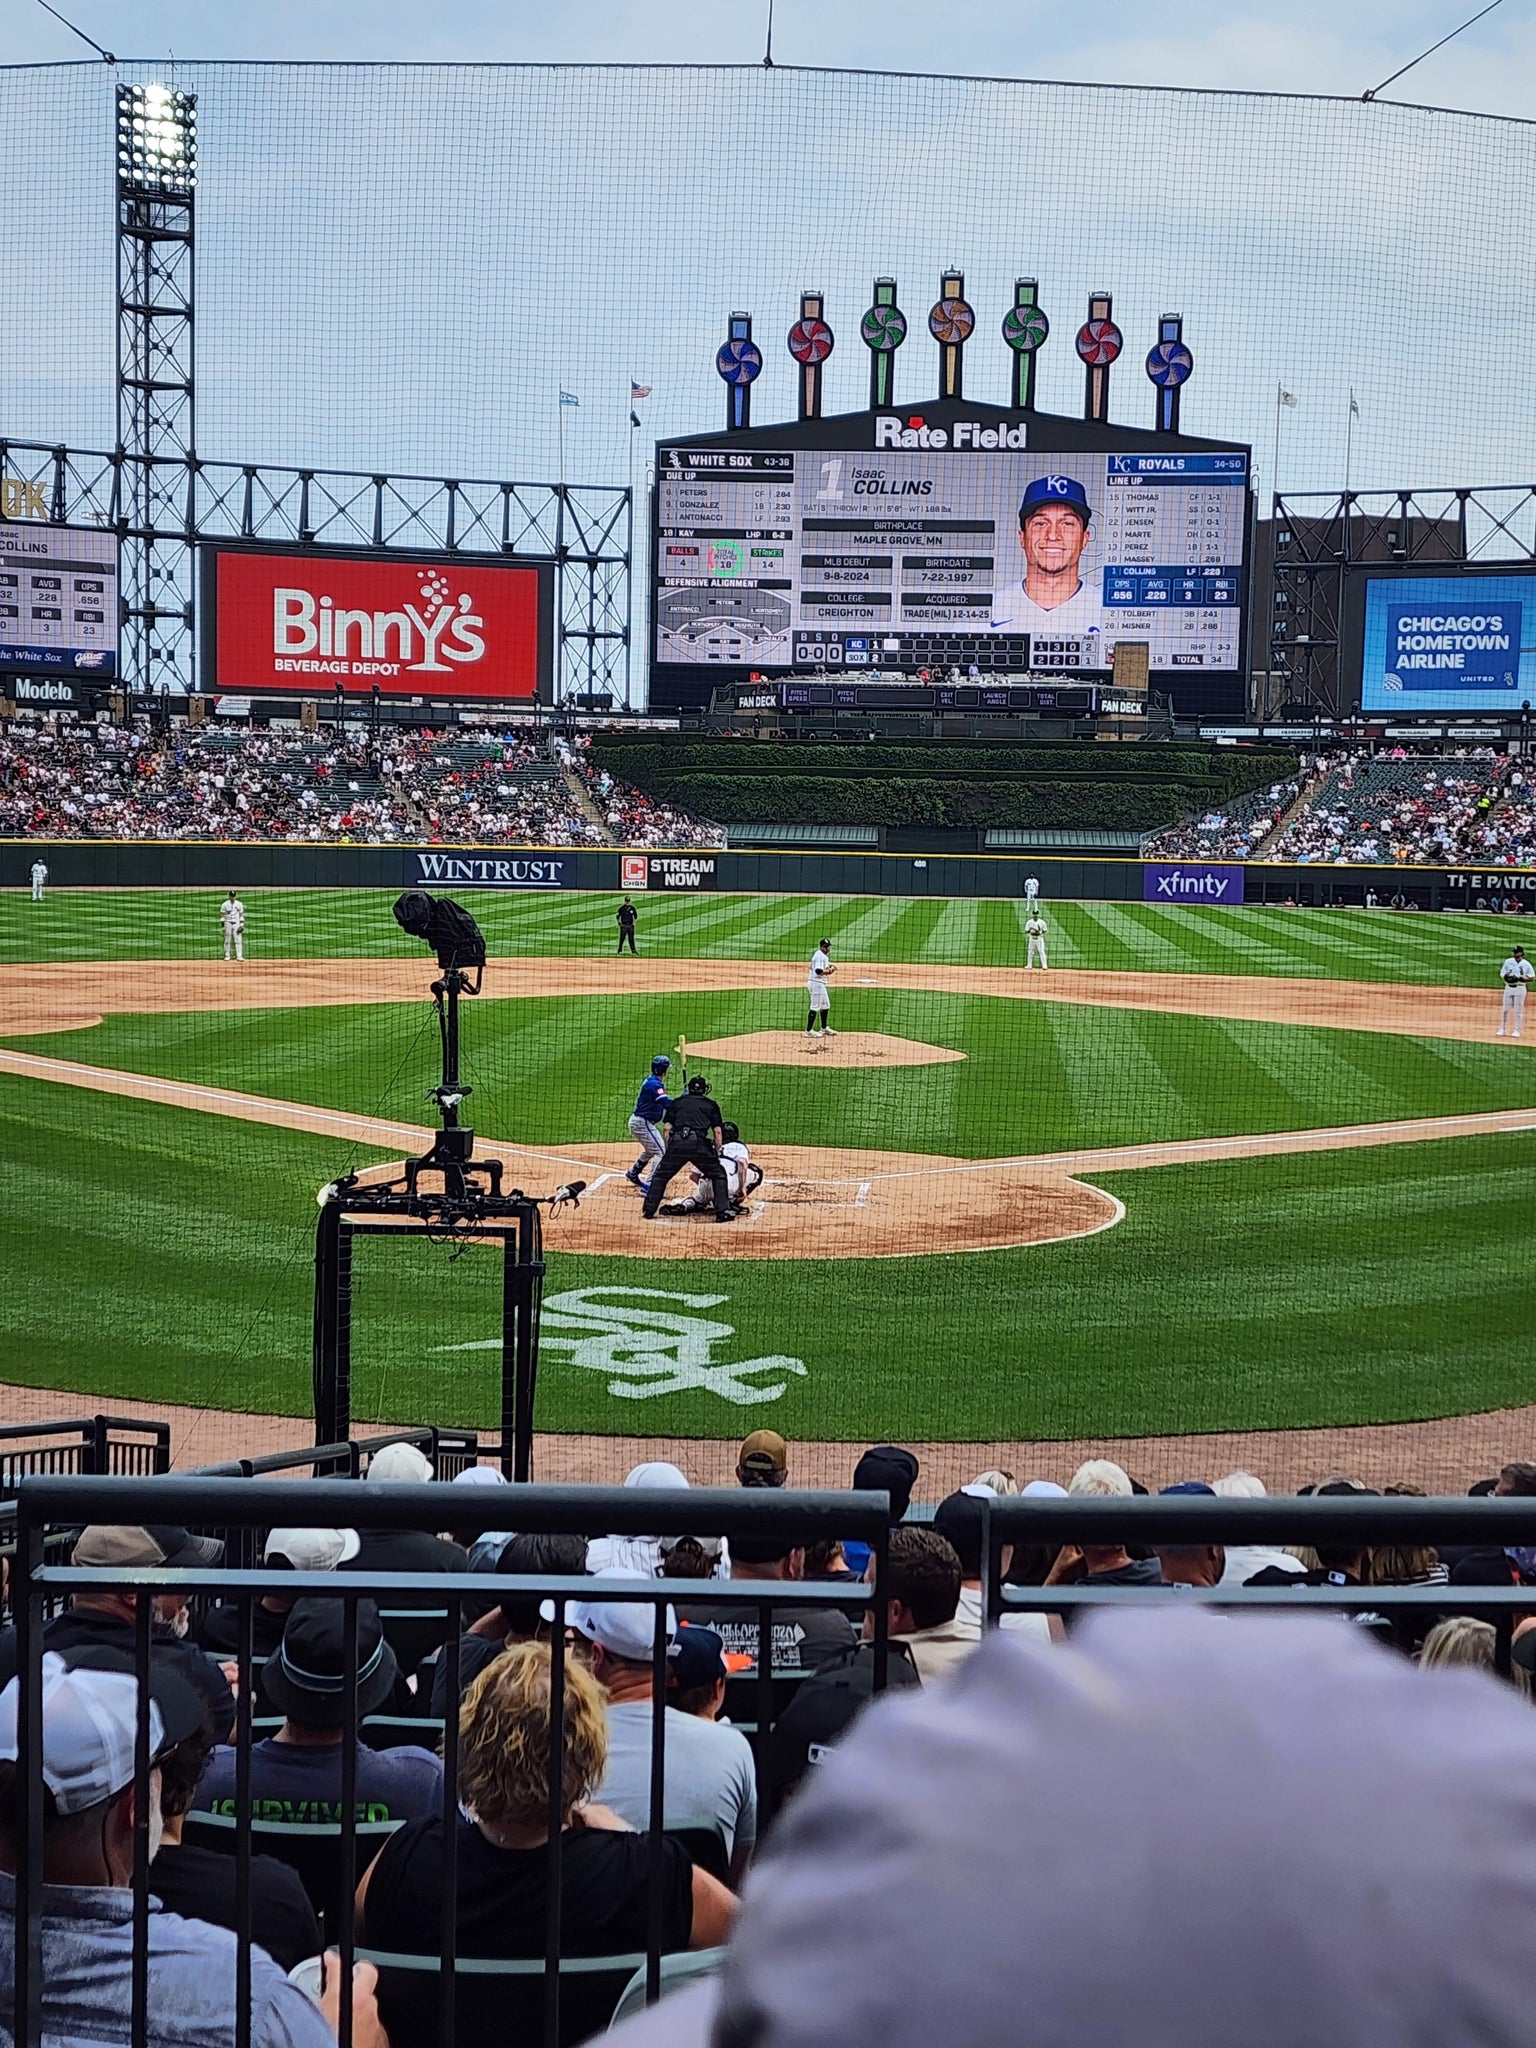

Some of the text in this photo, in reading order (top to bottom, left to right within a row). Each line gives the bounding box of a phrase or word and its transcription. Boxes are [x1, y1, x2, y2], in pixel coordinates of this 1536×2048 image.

[875, 416, 1026, 448] Rate Field
[689, 455, 725, 466] WHITE
[729, 456, 753, 466] SOX
[1113, 456, 1242, 473] KC ROYALS 34-50
[666, 472, 696, 480] DUE UP
[851, 468, 886, 479] Isaac
[1047, 476, 1067, 494] KC
[1109, 477, 1143, 485] LINE UP
[853, 480, 933, 495] COLLINS
[755, 490, 765, 498] CF
[679, 513, 723, 521] ANTONACCI
[874, 522, 923, 530] BIRTHPLACE
[853, 535, 943, 546] MAPLE GROVE, MN
[671, 547, 694, 555] BALLS
[823, 558, 870, 567] MLB DEBUT
[925, 559, 970, 567] BIRTHDATE
[823, 572, 870, 581] 9-8-2024
[921, 573, 974, 581] 7-22-1997
[38, 580, 54, 588] AVG
[664, 578, 759, 587] DEFENSIVE ALIGNMENT
[35, 593, 57, 602] .228
[827, 594, 865, 602] COLLEGE:
[925, 595, 969, 604] ACQUIRED:
[1185, 591, 1192, 600] 3
[1214, 591, 1227, 600] 23
[41, 610, 96, 620] HR RBI
[818, 608, 874, 617] CREIGHTON
[903, 608, 990, 619] TRADE (MIL) 12-14-25
[1398, 616, 1503, 633] CHICAGO'S
[851, 640, 878, 649] KC 1
[1038, 643, 1092, 651] 1 3 0 2
[1397, 634, 1510, 651] HOMETOWN
[14, 651, 62, 662] White Sox
[872, 654, 878, 662] 2
[1037, 656, 1091, 665] 2 2 0 1
[1176, 656, 1201, 664] TOTAL
[1396, 653, 1465, 669] AIRLINE
[274, 658, 400, 676] BEVERAGE DEPOT
[15, 677, 73, 701] Modelo
[739, 695, 777, 708] FAN DECK
[1101, 700, 1142, 714] FAN DECK
[417, 854, 564, 881] WINTRUST
[650, 859, 714, 873] STREAM
[664, 873, 700, 886] NOW
[1157, 871, 1229, 898] xfinity
